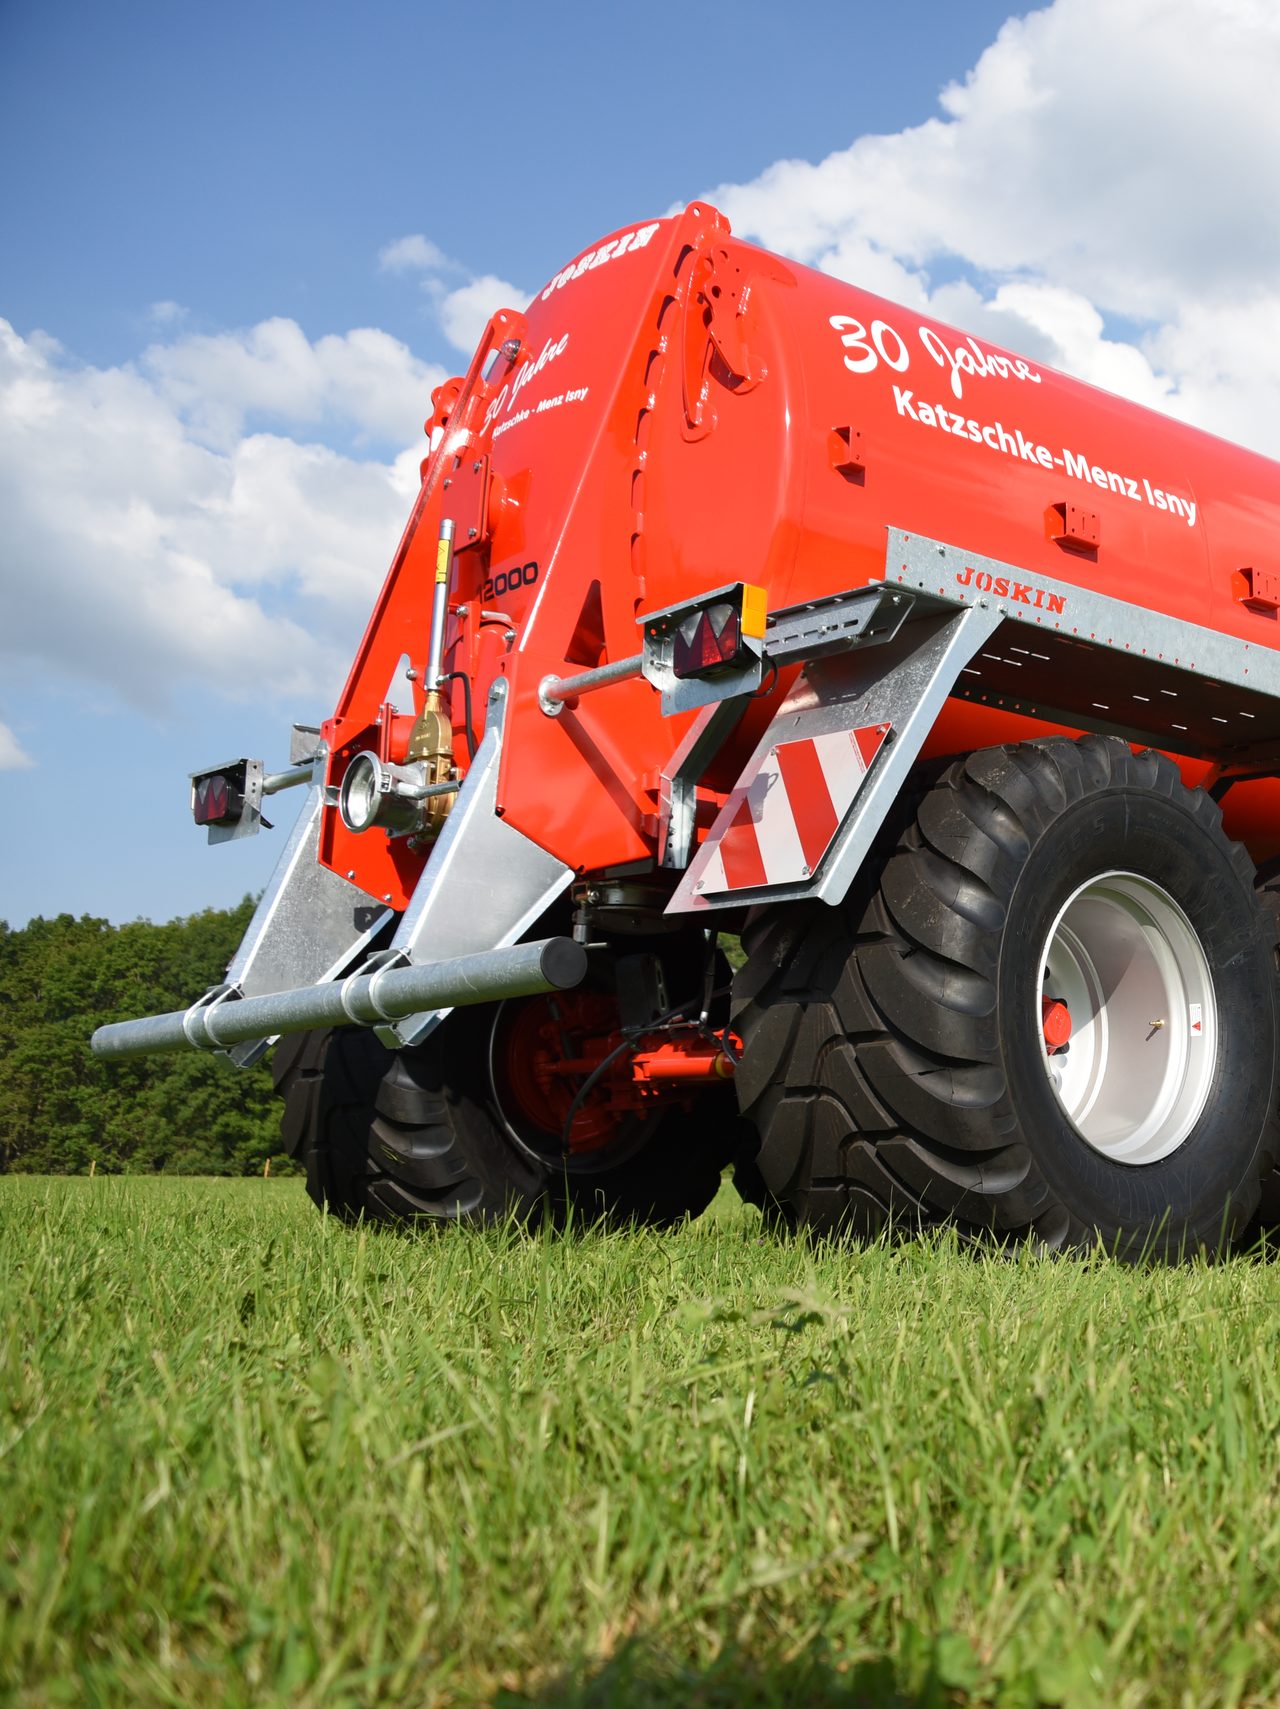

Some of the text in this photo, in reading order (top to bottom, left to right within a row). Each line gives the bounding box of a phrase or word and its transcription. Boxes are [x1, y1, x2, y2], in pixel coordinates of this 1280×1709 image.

[541, 222, 660, 301] JOSKIN
[479, 333, 569, 437] 30 Jahre
[829, 315, 1041, 399] 30 Jahre
[536, 395, 564, 413] Menz
[565, 386, 589, 402] Isny
[892, 385, 1197, 526] Katzschke-Menz Isny
[956, 566, 1067, 615] JOSKIN
